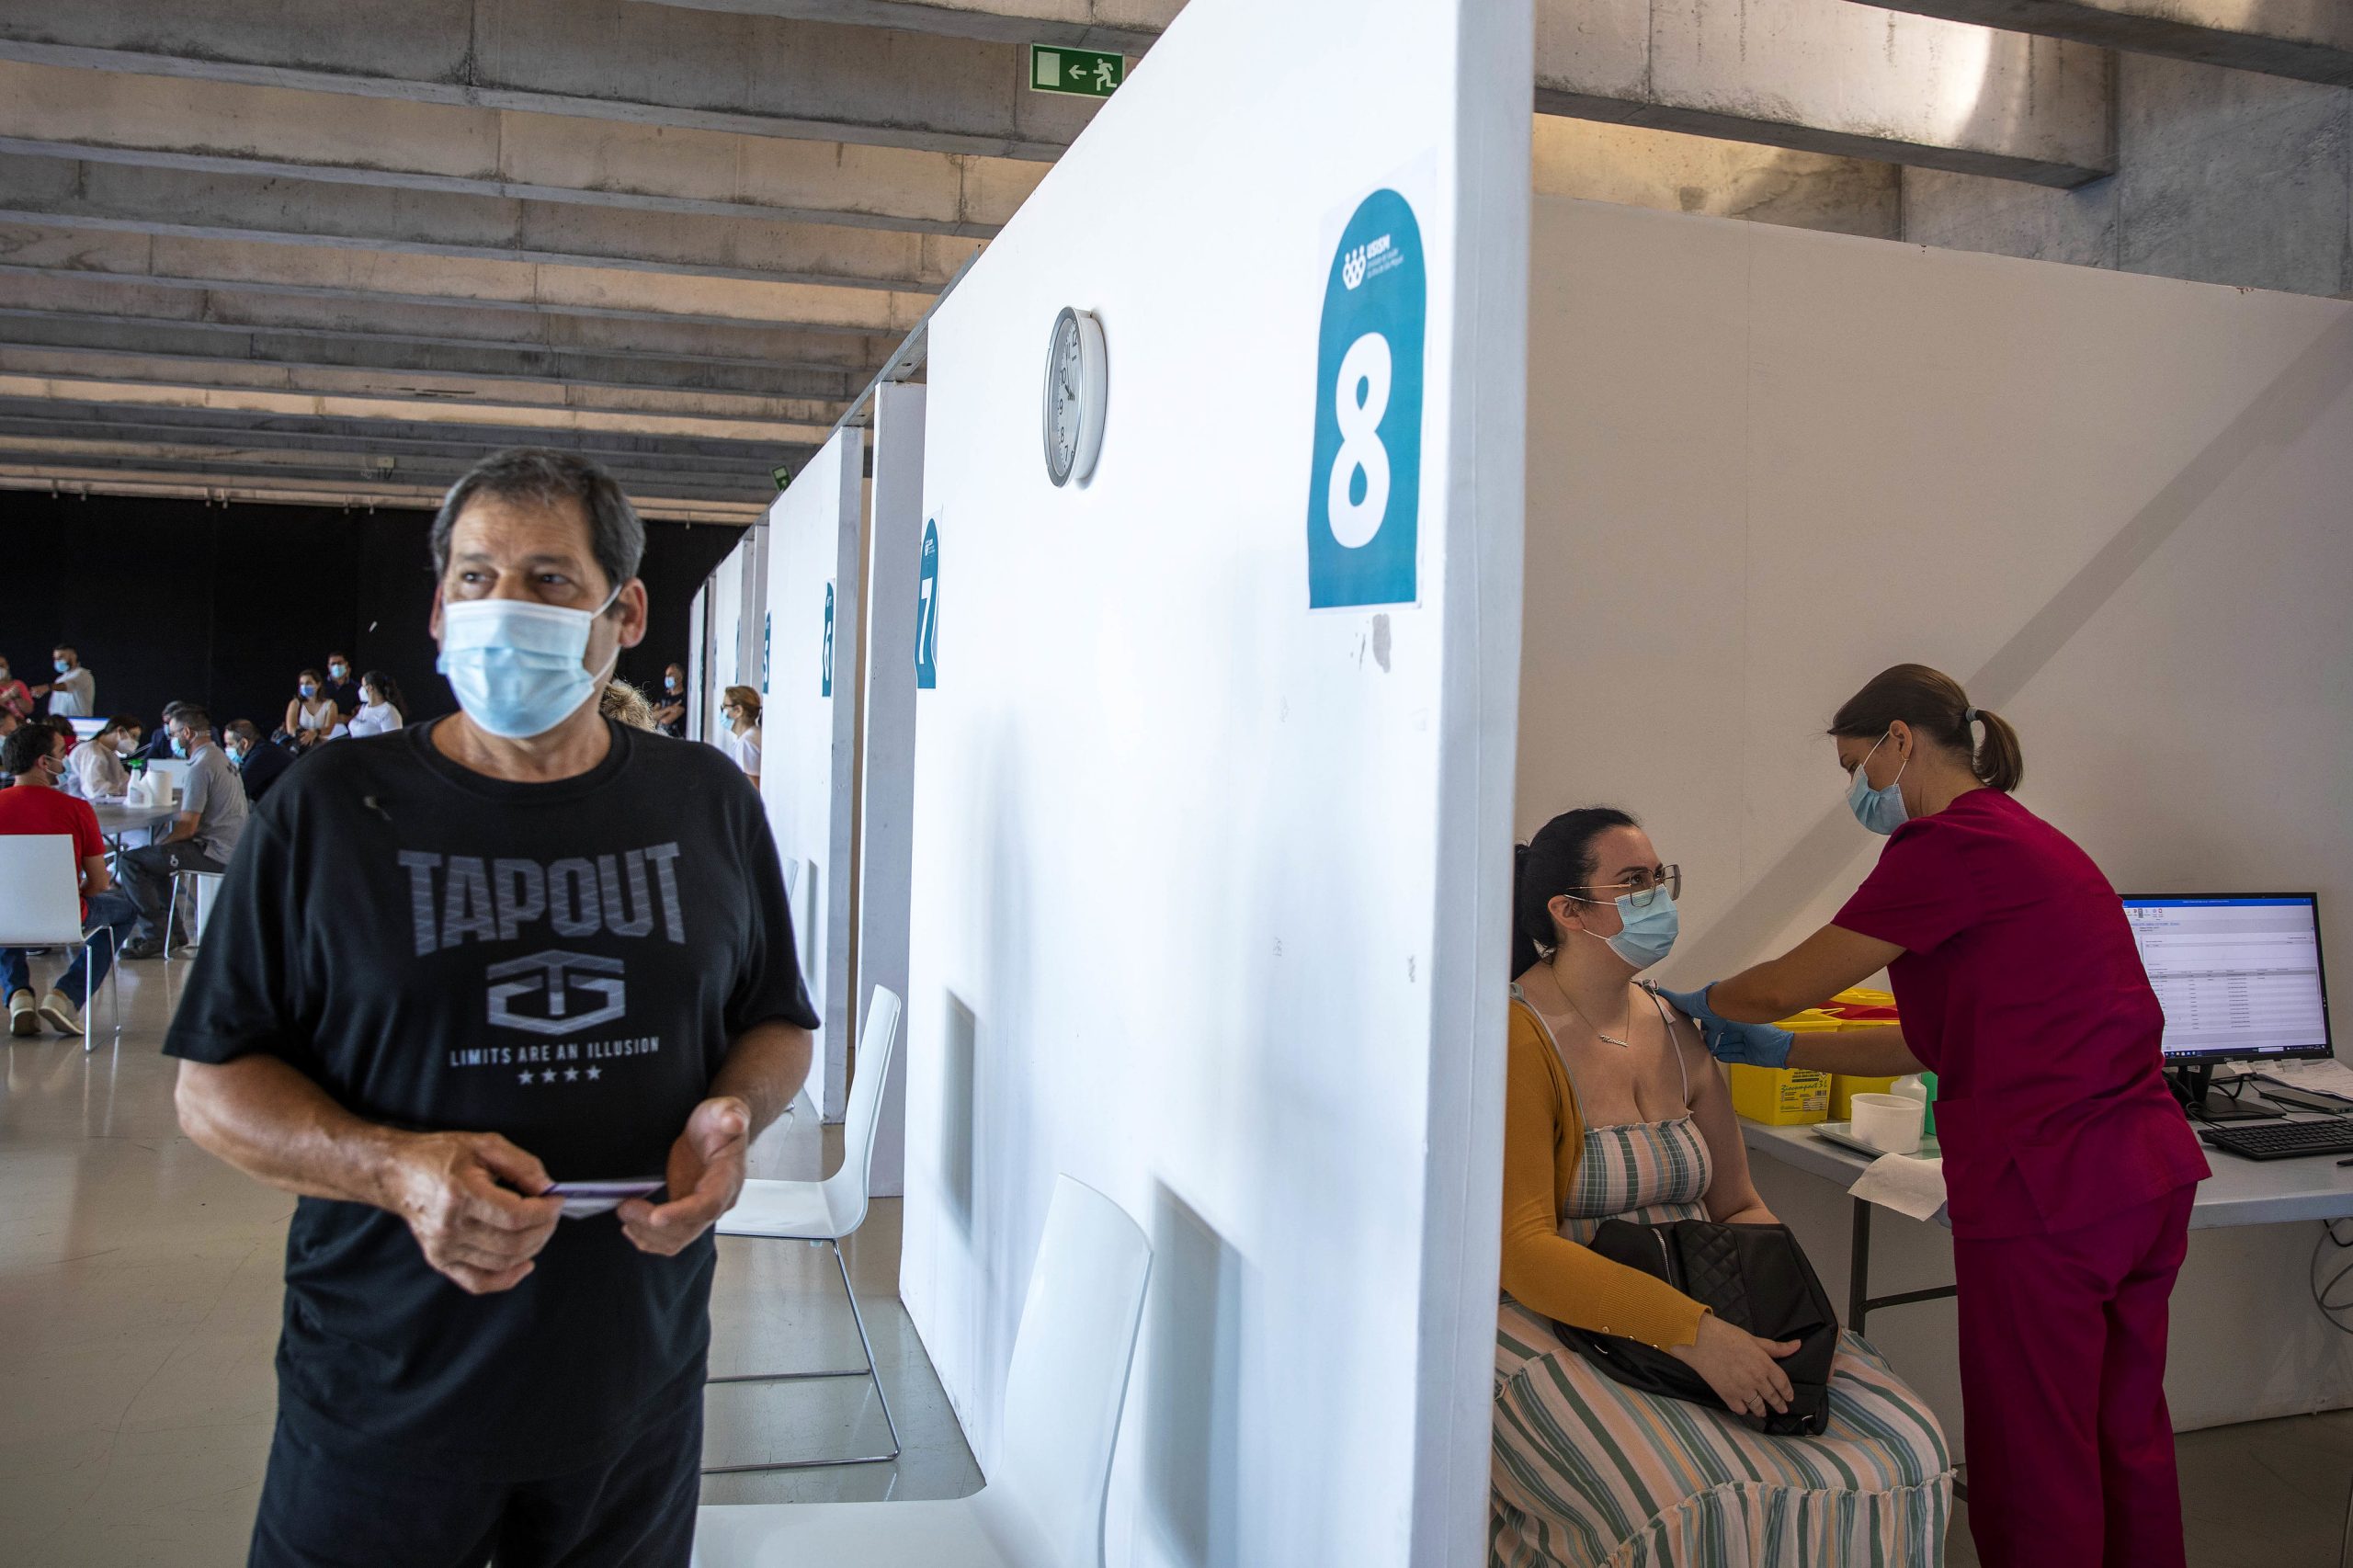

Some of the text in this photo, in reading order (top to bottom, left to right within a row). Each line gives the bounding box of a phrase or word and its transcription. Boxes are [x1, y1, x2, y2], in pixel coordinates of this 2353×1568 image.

[1059, 398, 1063, 415] 9
[1060, 426, 1065, 443] 8
[1327, 331, 1392, 550] 8
[824, 620, 832, 681] 6
[919, 576, 933, 665] 7
[397, 841, 686, 957] TAPOUT
[449, 1035, 661, 1067] LIMITS ARE AN ILLUSION
